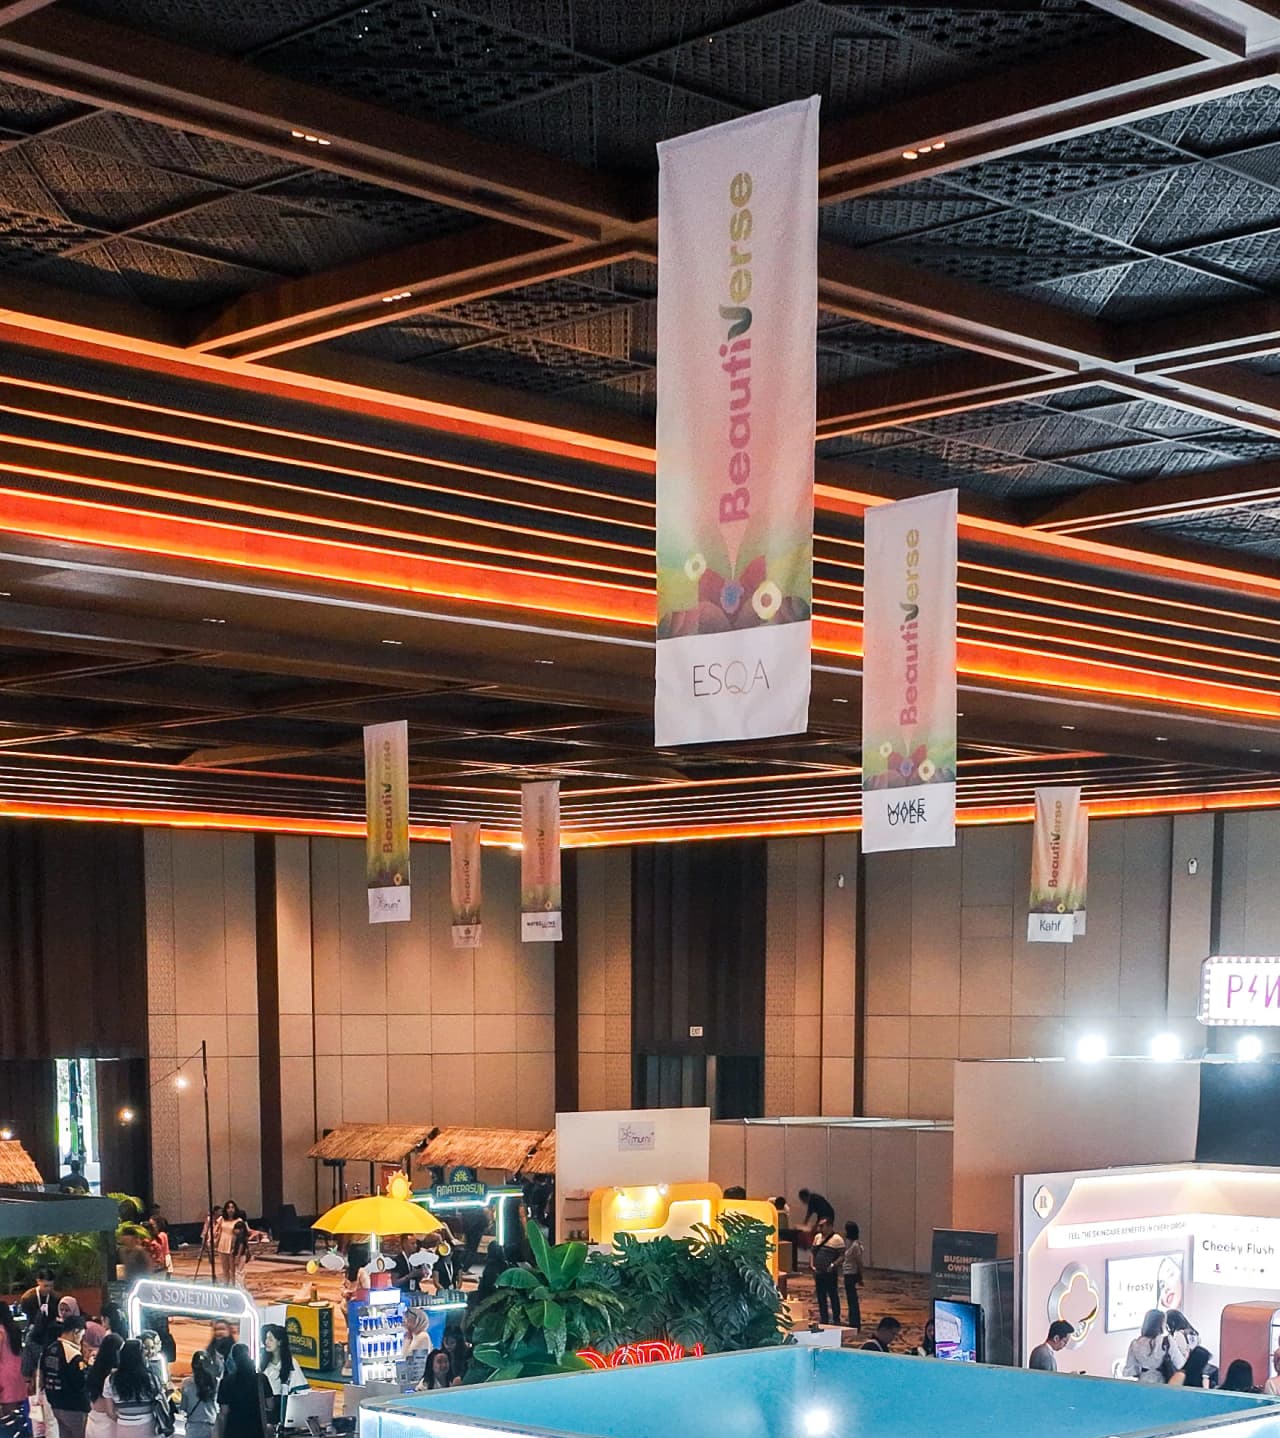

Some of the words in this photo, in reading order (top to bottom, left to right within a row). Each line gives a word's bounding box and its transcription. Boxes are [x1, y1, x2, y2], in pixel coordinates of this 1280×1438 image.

[692, 664, 771, 698] ESQA
[1202, 1239, 1242, 1256] Cheeky
[1246, 1243, 1275, 1256] Flush
